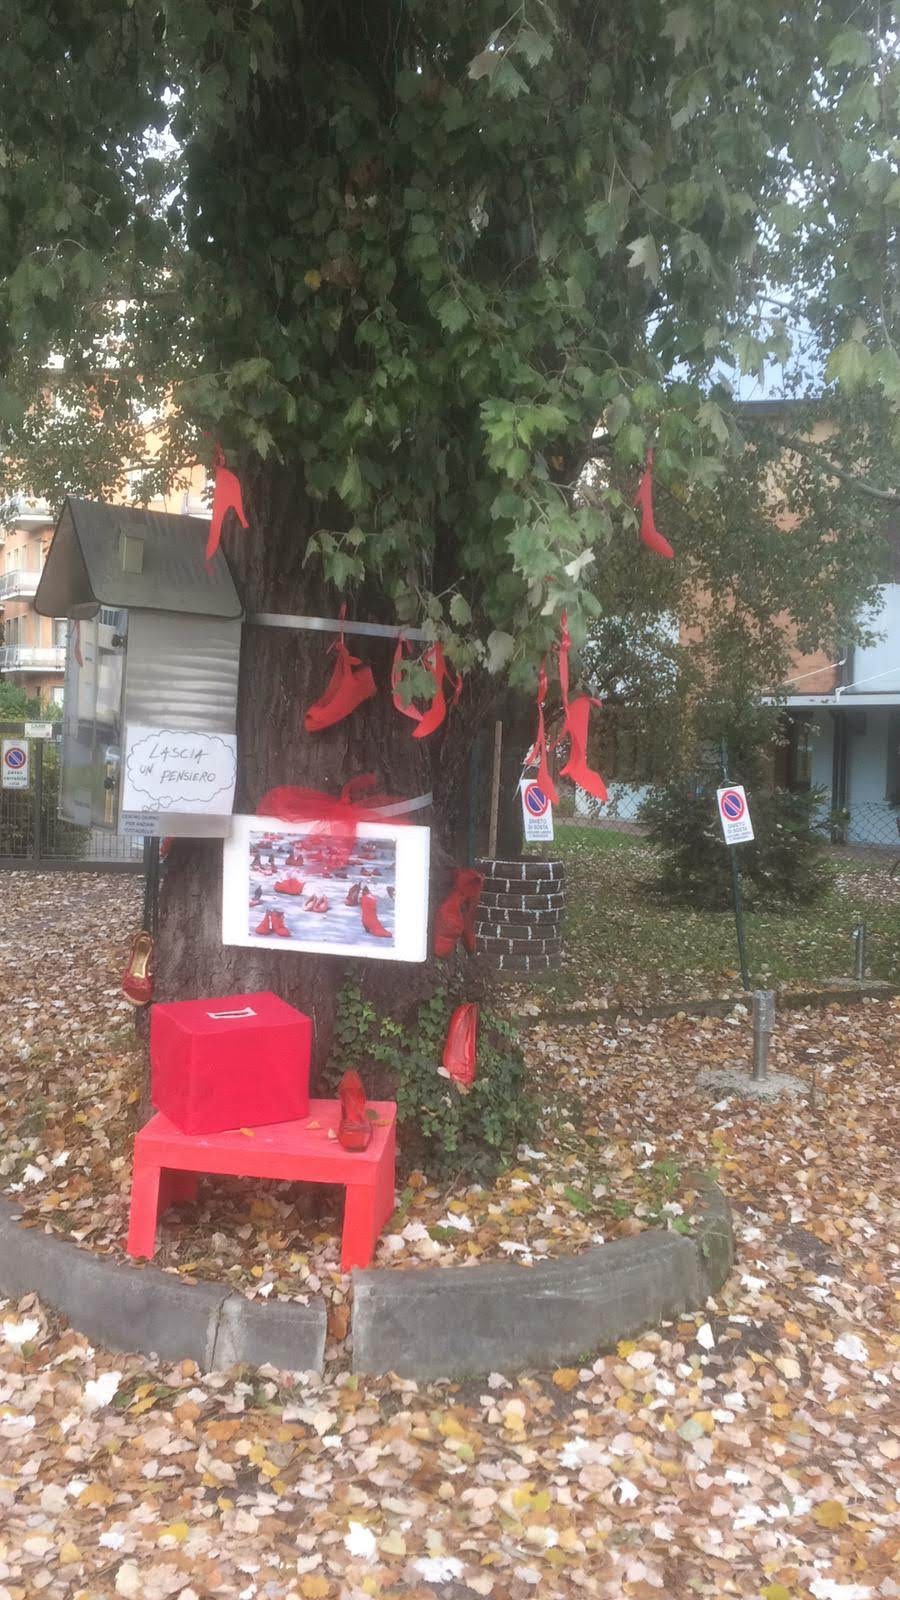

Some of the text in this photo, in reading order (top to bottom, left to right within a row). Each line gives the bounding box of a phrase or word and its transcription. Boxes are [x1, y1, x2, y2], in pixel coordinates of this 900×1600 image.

[149, 744, 209, 763] LASCIA
[140, 763, 216, 784] UN PENSIERO
